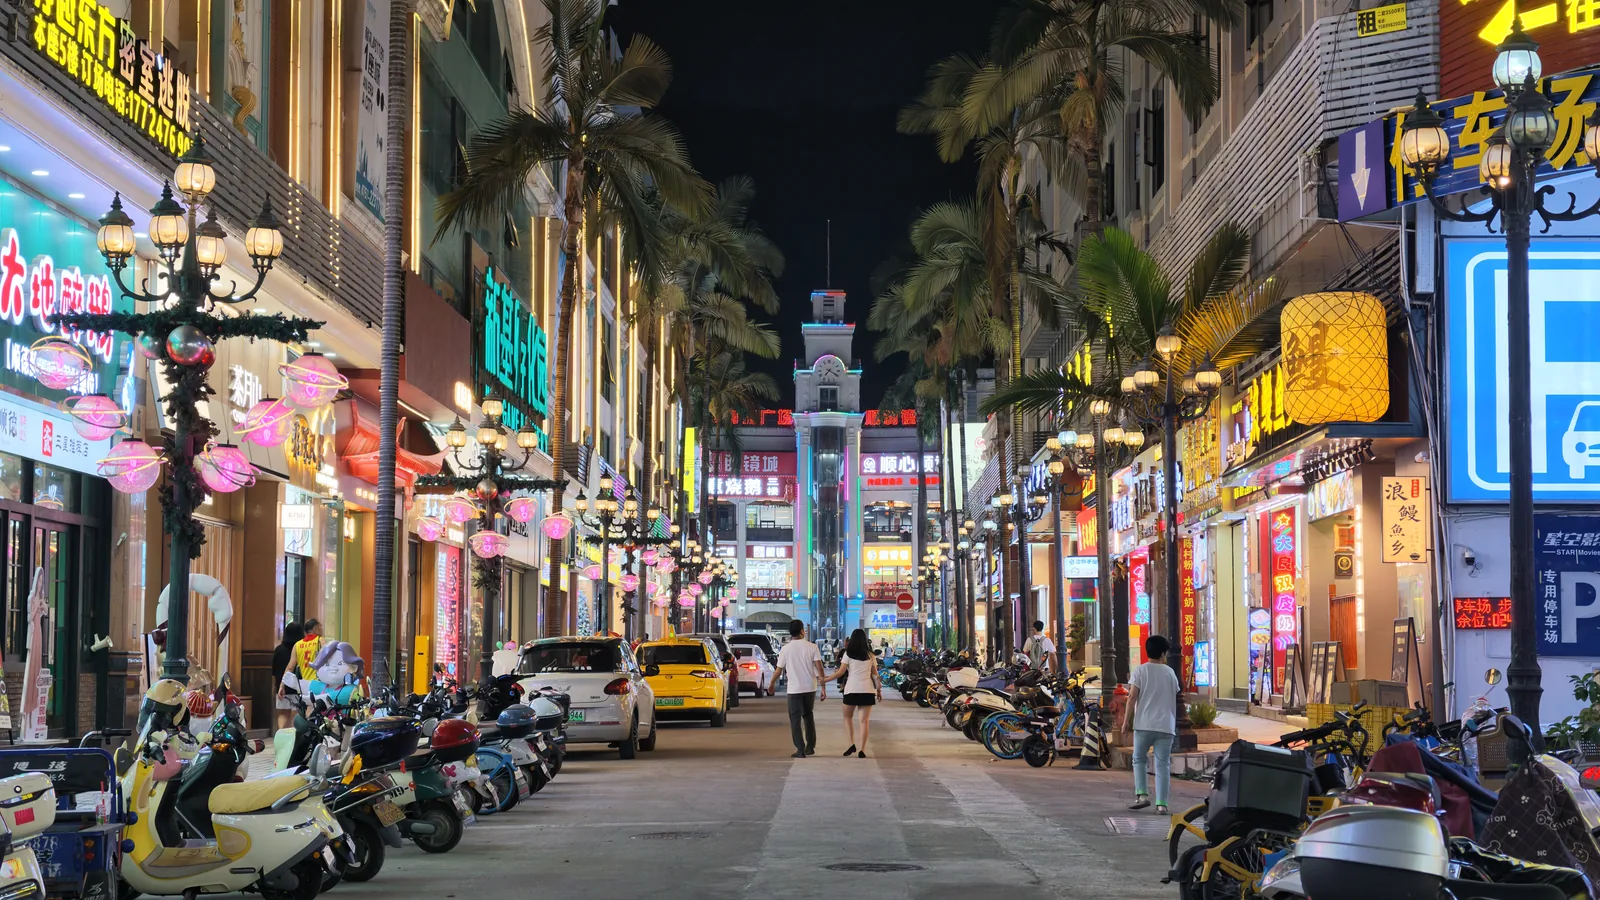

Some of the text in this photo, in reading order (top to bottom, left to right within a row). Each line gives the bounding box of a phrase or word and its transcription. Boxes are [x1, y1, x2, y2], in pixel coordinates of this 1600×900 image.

[1358, 11, 1377, 35] 租
[1275, 535, 1294, 631] 大良双皮奶
[1543, 569, 1558, 644] 专用停车场
[1560, 572, 1600, 644] P
